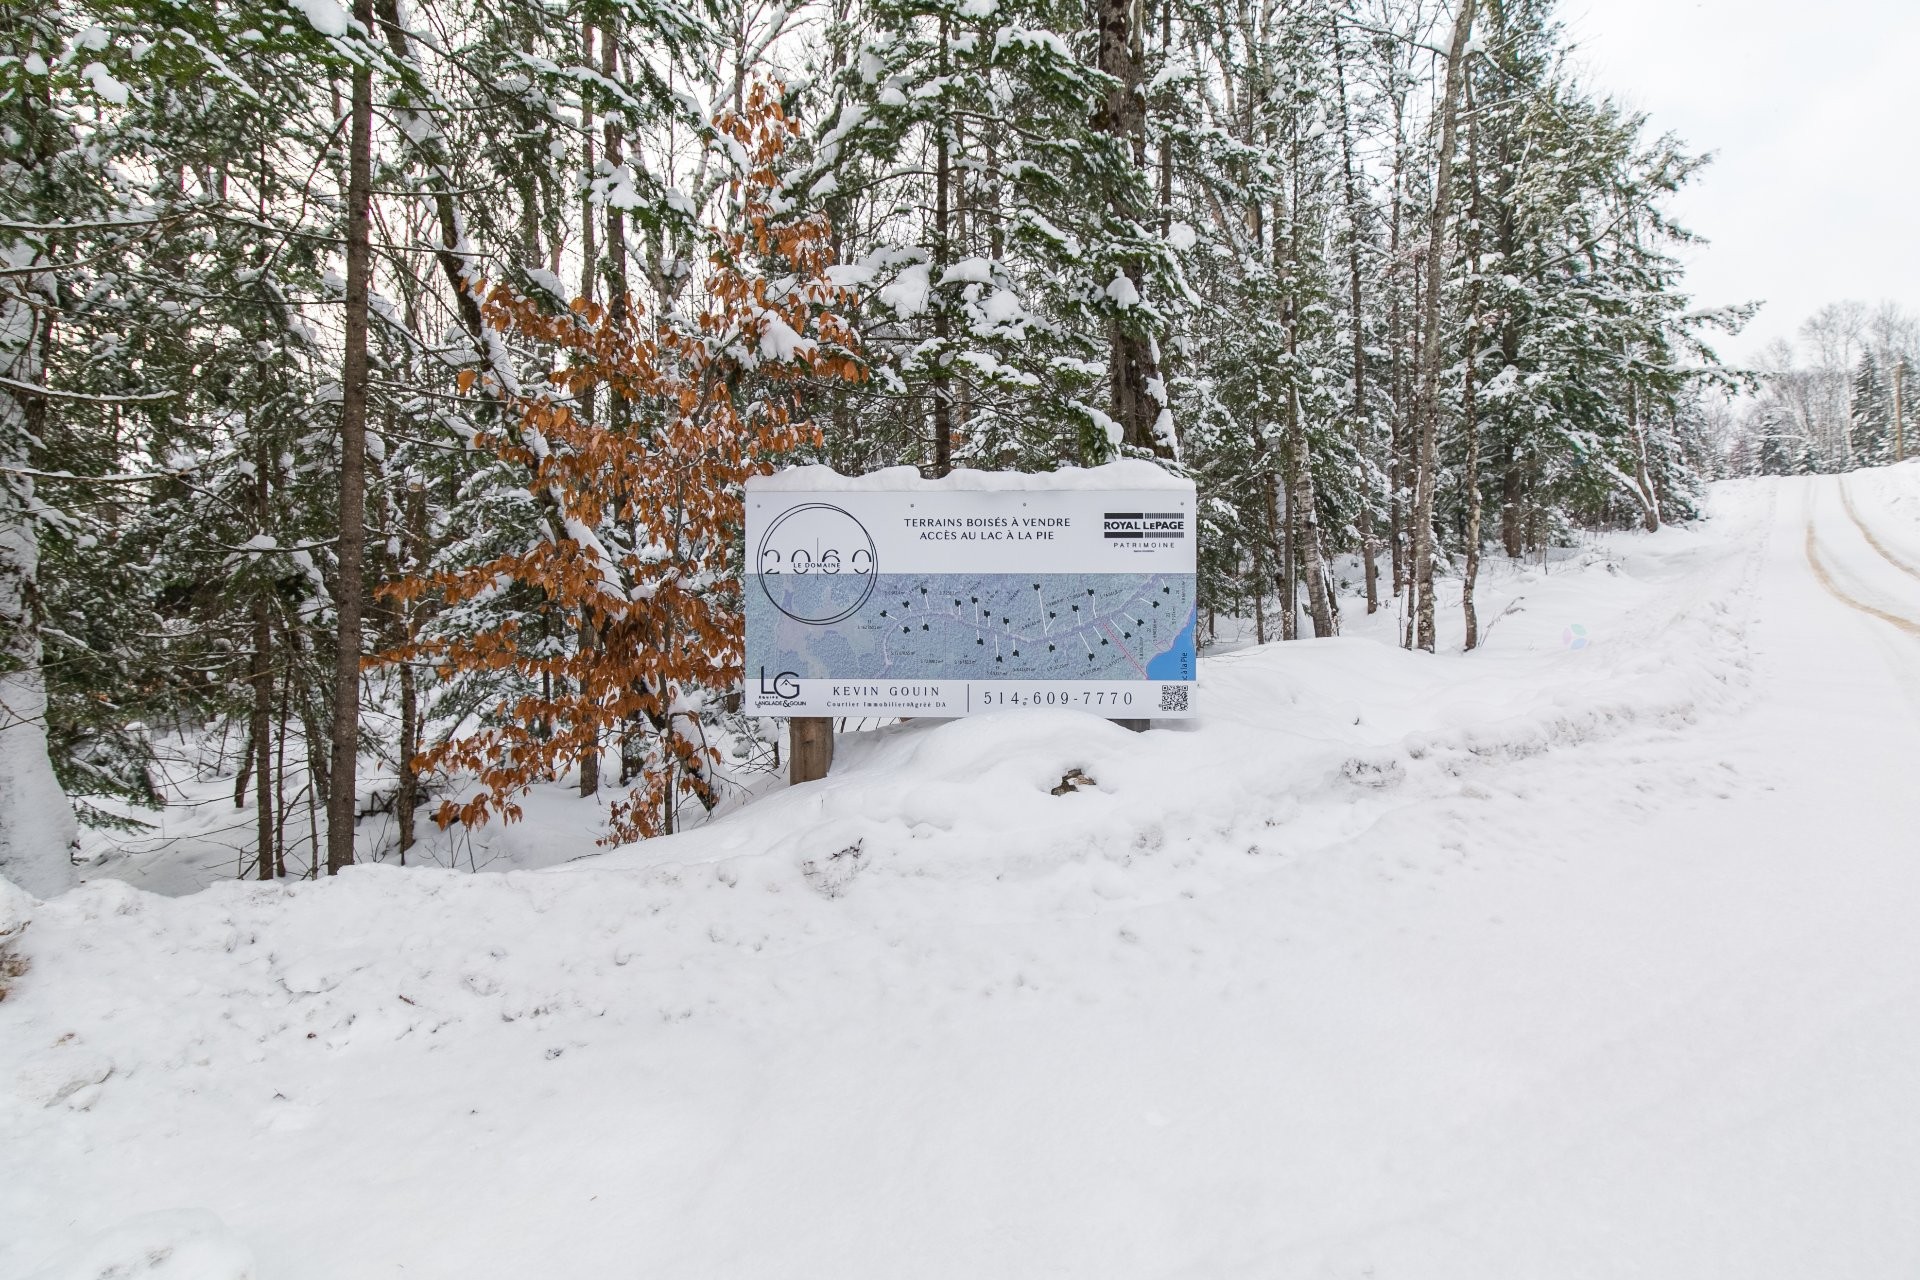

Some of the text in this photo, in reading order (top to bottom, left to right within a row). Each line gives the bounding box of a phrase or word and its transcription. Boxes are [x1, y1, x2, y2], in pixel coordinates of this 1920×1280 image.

[904, 516, 1071, 527] TERRAINS BOISÉS À VENDRE
[1103, 521, 1141, 530] ROYAL
[919, 530, 1054, 540] ACCÈS AU LAC À LA PIE
[833, 686, 940, 697] KEVIN GOUIN
[983, 691, 1133, 705] 514-609-7770
